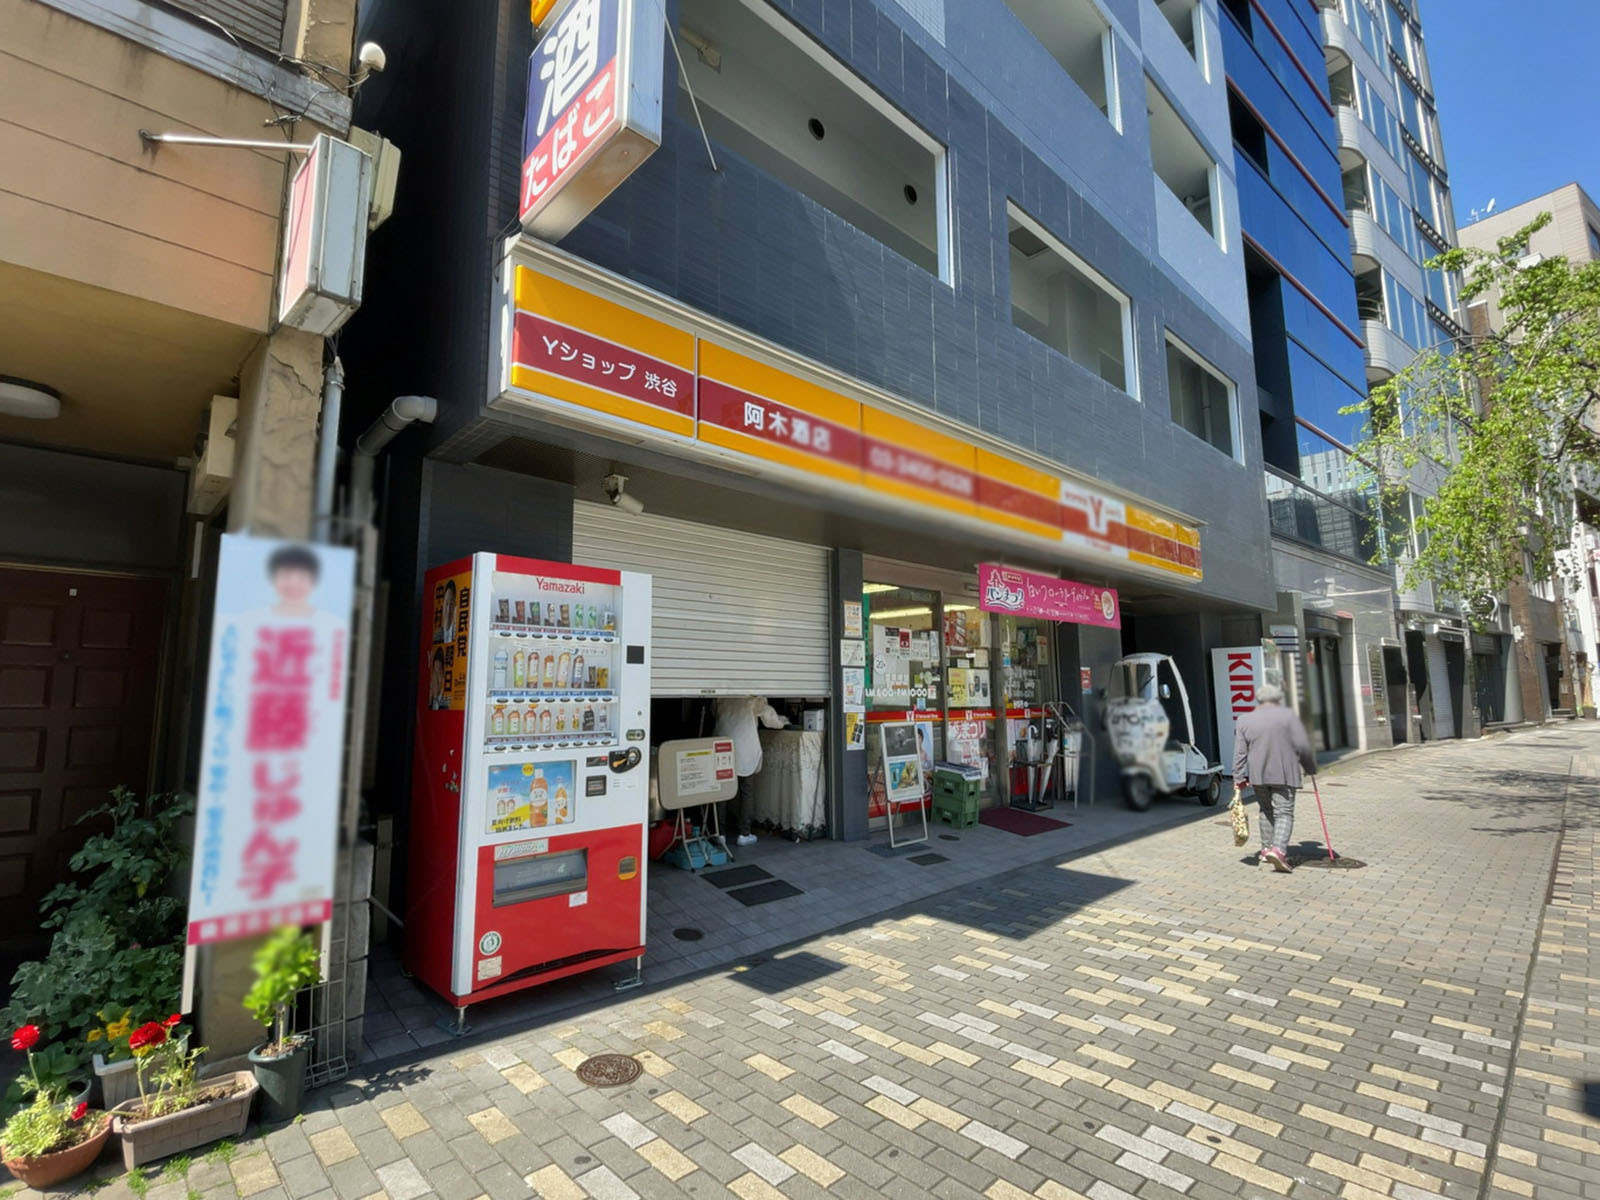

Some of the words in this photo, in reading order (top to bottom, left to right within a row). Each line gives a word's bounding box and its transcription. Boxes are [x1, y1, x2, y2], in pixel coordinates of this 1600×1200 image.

[537, 0, 601, 137] 酒
[523, 71, 611, 209] たばこ
[644, 371, 678, 398] 渋谷
[536, 577, 585, 595] Yamazaki
[1227, 652, 1256, 721] KIRI
